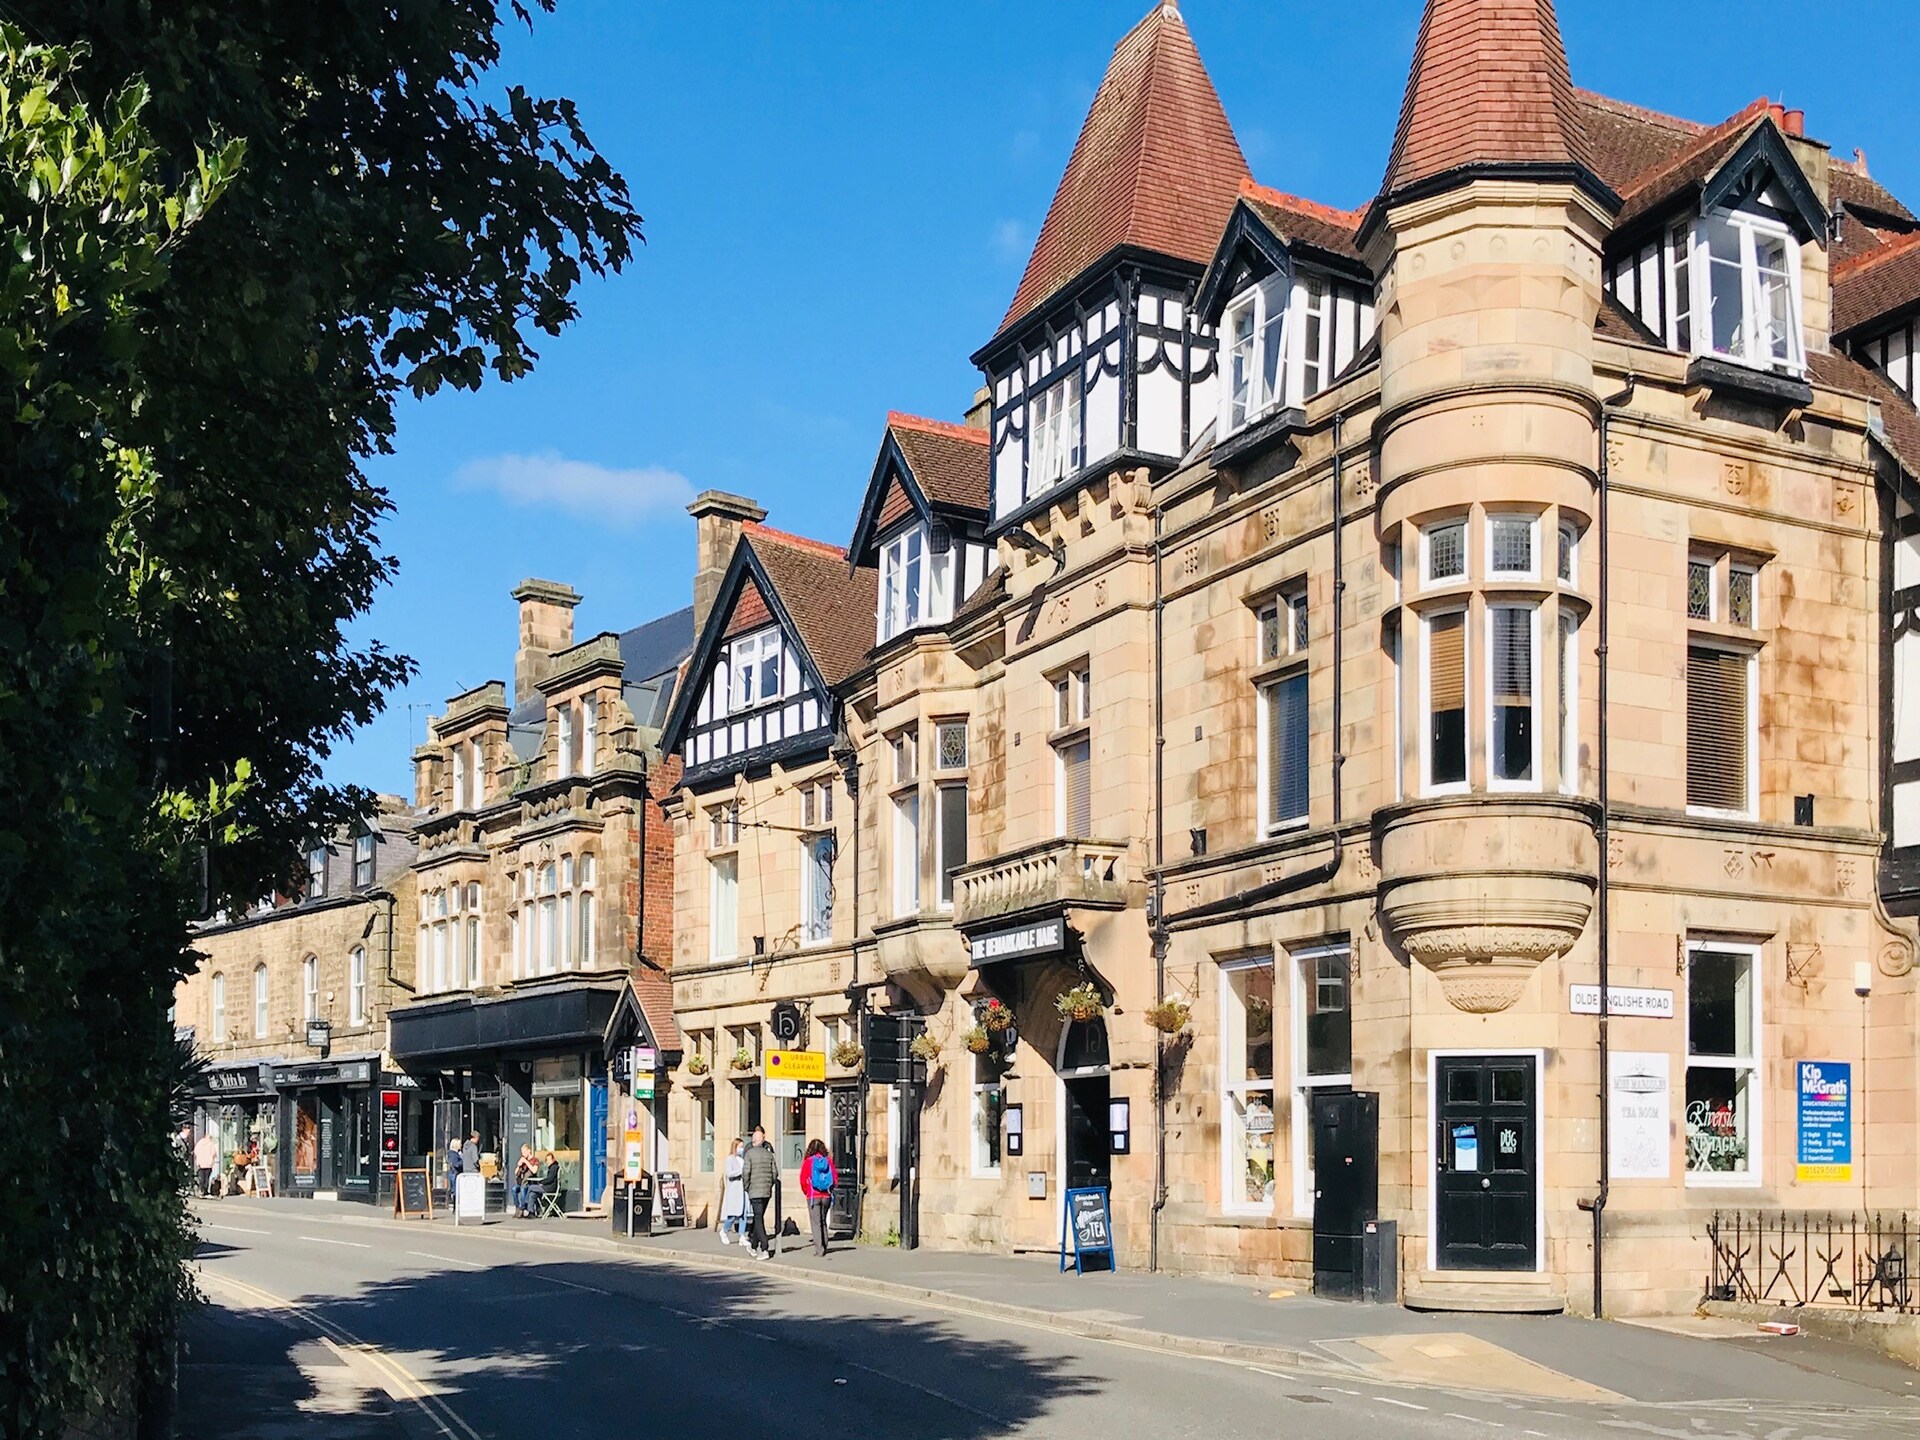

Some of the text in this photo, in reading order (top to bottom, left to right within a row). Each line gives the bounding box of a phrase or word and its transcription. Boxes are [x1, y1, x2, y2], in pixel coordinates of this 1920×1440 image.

[971, 924, 1058, 960] THE REMARKABLE HARE
[1575, 993, 1669, 1009] OLDE NGLISHE ROAD
[790, 1054, 814, 1062] URBAN
[783, 1063, 820, 1071] CLEARWAY
[1802, 1064, 1822, 1084] Kip
[1802, 1079, 1847, 1095] McGrath
[1621, 1106, 1660, 1119] TEA ROOM
[1685, 1100, 1737, 1128] Riversi
[1500, 1129, 1517, 1147] DOG
[1089, 1221, 1106, 1238] TEA
